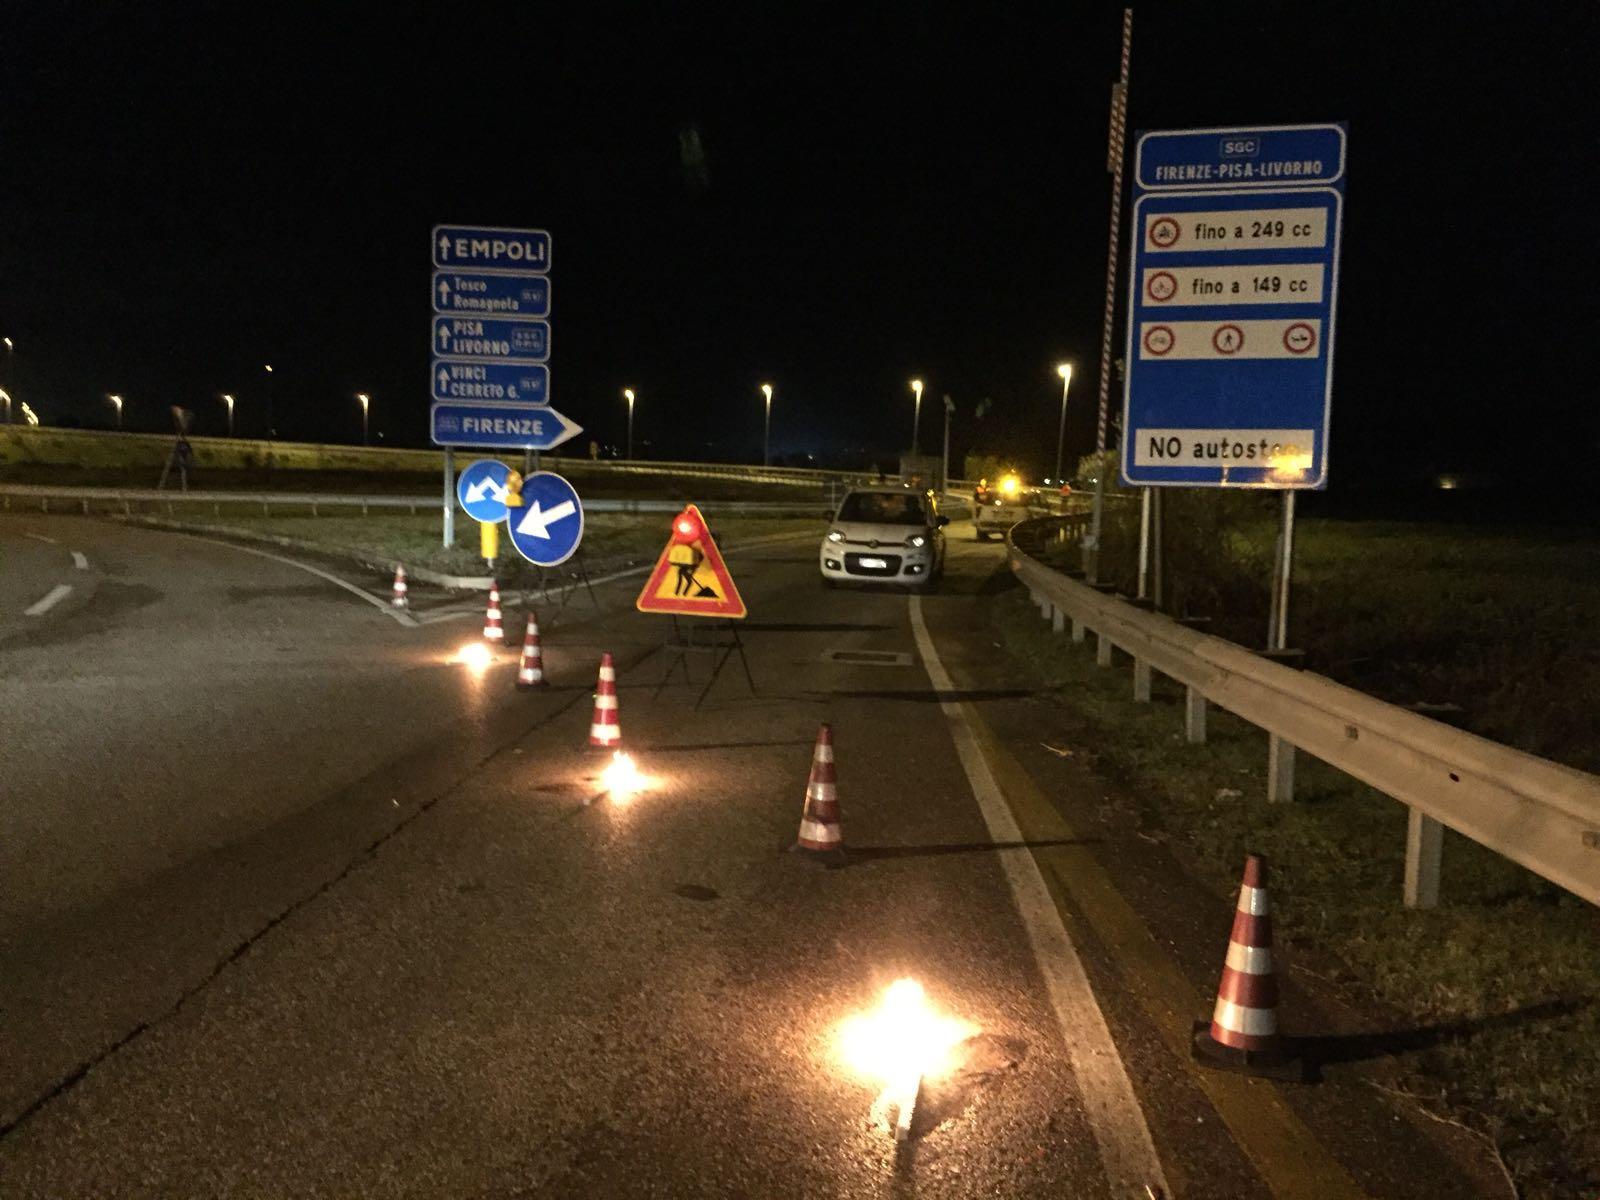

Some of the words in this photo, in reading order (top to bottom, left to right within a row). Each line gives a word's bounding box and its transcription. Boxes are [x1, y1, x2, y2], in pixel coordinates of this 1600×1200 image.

[1224, 142, 1256, 154] SGC
[1155, 161, 1323, 180] FIRENZE-PISA-LIVORNO
[1195, 223, 1226, 240] fino
[1234, 225, 1243, 239] a
[1251, 221, 1285, 238] 249
[1292, 224, 1311, 237] cc
[455, 239, 544, 261] EMPOLI
[1192, 278, 1224, 295] fino
[1231, 279, 1240, 293] a
[1253, 276, 1281, 292] 149
[1289, 279, 1308, 292] cc
[453, 294, 519, 312] Romagnola
[453, 320, 484, 336] PISA
[453, 339, 510, 355] LIVORNO
[451, 366, 486, 381] VINCI
[451, 383, 504, 398] CERRETO
[507, 385, 520, 399] G.
[462, 417, 544, 435] FIRENZE
[1149, 437, 1182, 458] NO
[1193, 438, 1299, 460] autosto
